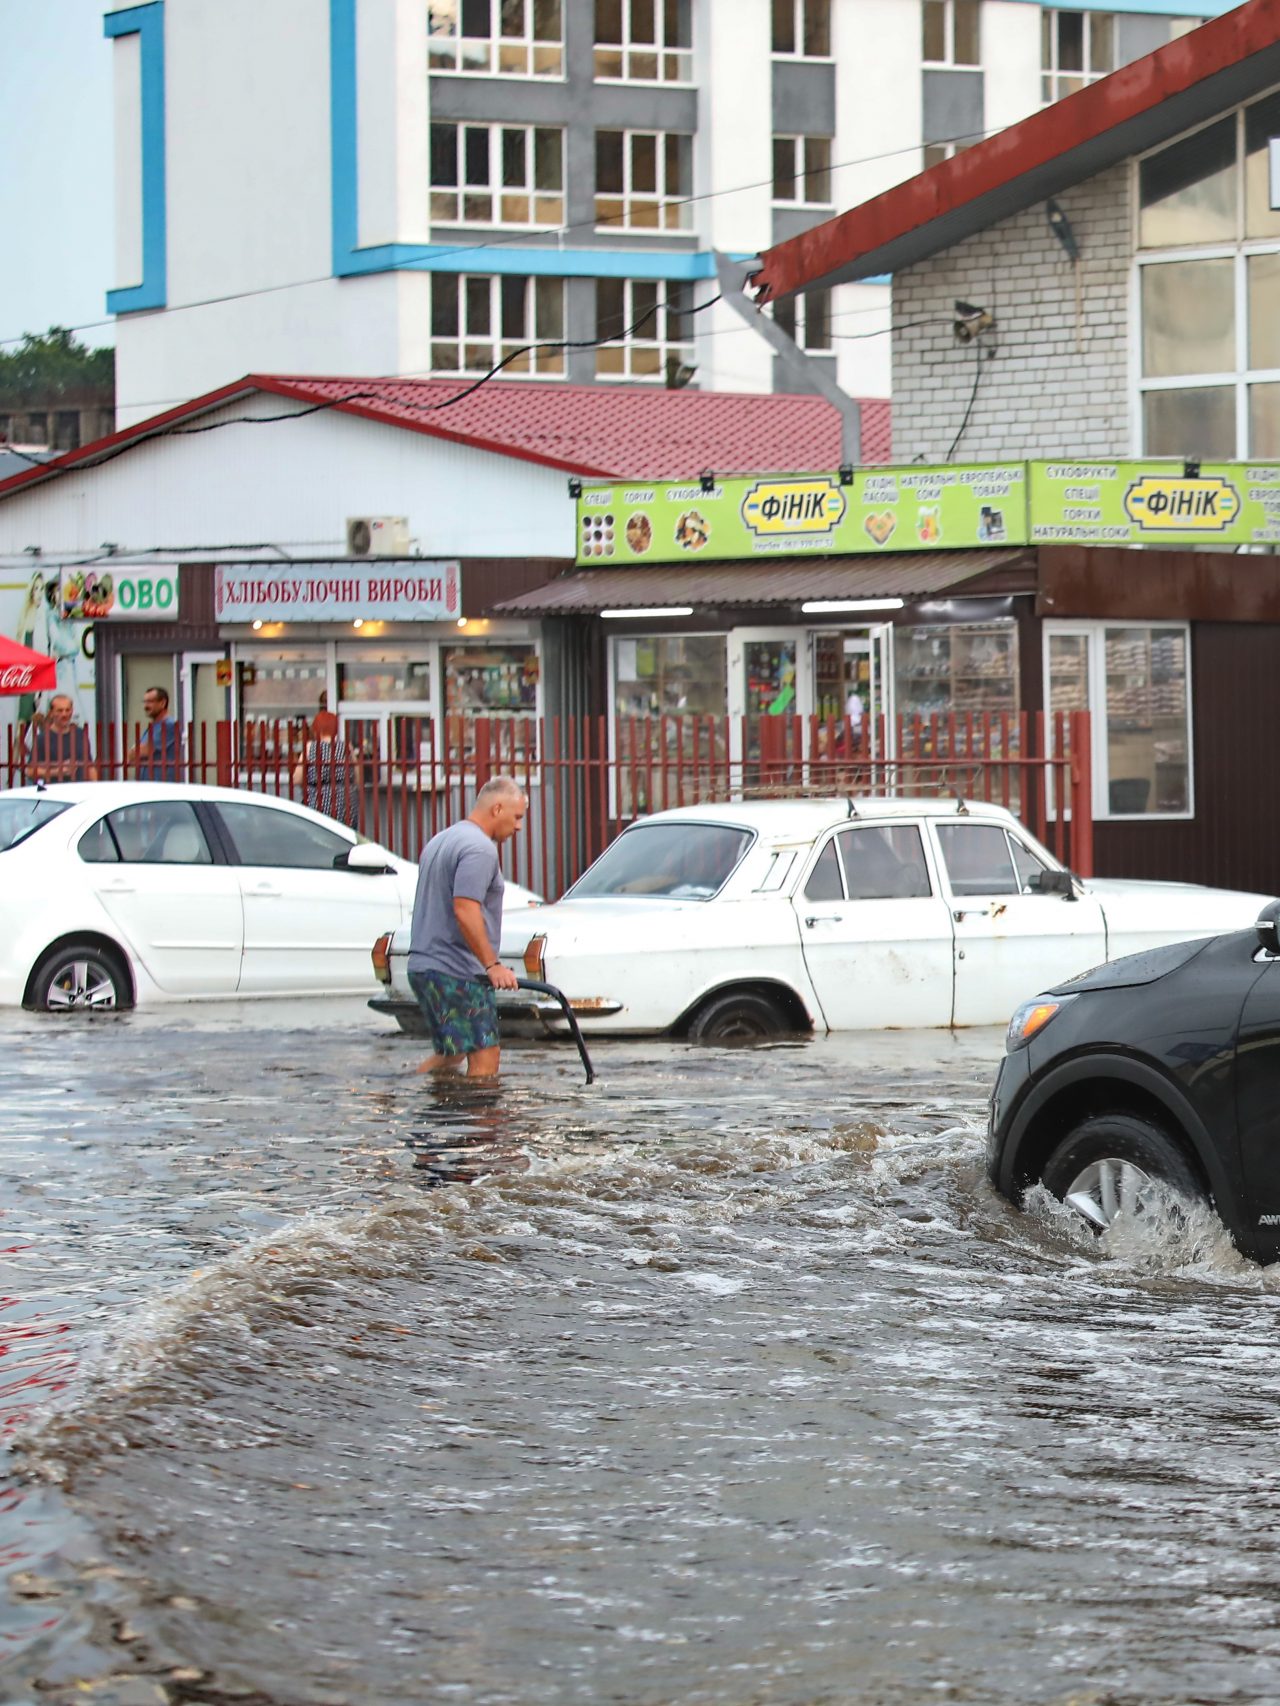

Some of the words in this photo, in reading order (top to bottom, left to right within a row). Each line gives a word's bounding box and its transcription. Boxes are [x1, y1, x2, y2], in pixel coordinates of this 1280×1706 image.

[1046, 465, 1117, 478] СУХОФРУКТИ
[916, 488, 941, 500] СОКИ
[972, 485, 1010, 497] ТОВАРИ
[1034, 526, 1099, 539] НАТУРАЛЬНІ
[1101, 526, 1130, 539] СОКИ
[118, 578, 179, 609] ОВО
[225, 578, 360, 604] ХЛІБОБУЛОЧНІ
[367, 578, 442, 603] ВИРОБИ
[0, 663, 37, 688] Cola
